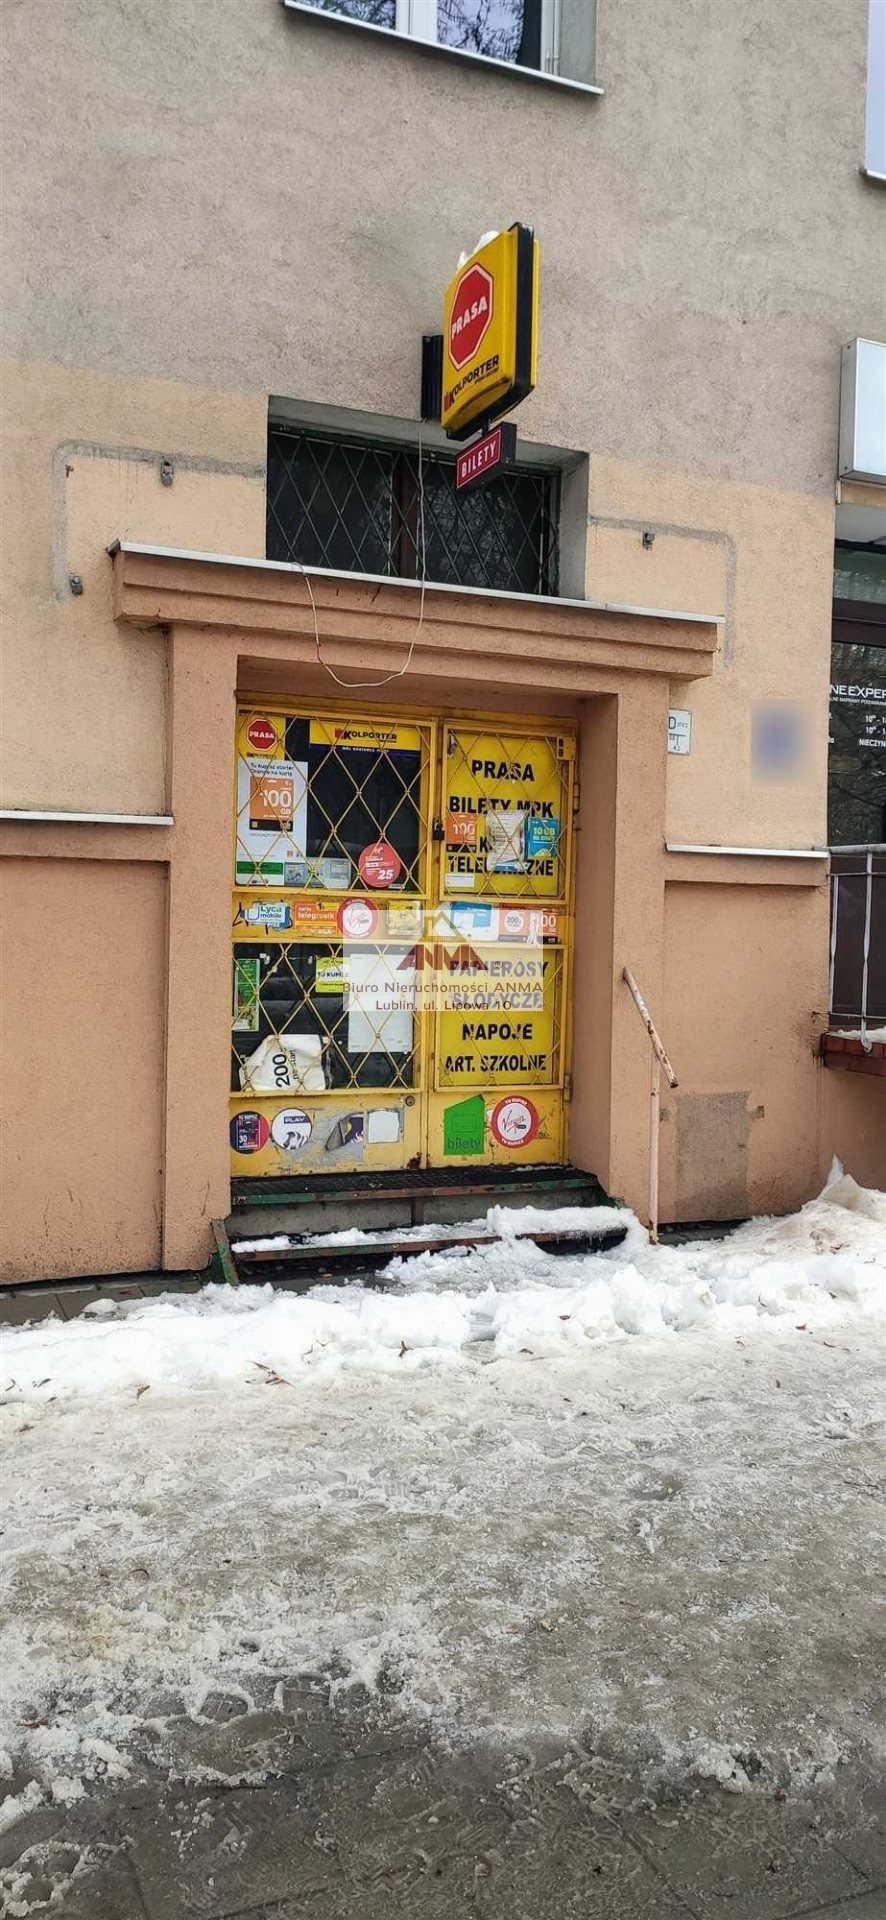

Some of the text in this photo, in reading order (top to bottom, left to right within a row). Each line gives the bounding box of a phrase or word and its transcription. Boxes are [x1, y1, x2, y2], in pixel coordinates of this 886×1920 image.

[451, 295, 488, 341] PRASA
[448, 354, 499, 407] KOLPORTER
[461, 440, 496, 478] BILETY
[249, 730, 275, 740] PRASA
[344, 729, 397, 741] KOLPORTER
[471, 759, 535, 782] PRASA
[259, 789, 292, 807] 100
[449, 796, 554, 818] BILETY MPK
[452, 822, 475, 836] 100
[533, 827, 543, 836] 10
[377, 869, 394, 880] 25
[448, 856, 553, 876] TELEZNE
[260, 905, 283, 915] Lyca
[450, 960, 549, 978] PAPIEROSY
[452, 992, 543, 1009] SŁODYCZE
[462, 1023, 533, 1041] NAPOJE
[272, 1053, 291, 1088] 200
[445, 1055, 547, 1073] ART. SZKOLNE
[501, 1109, 527, 1134] Virgin
[238, 1134, 248, 1143] 30
[447, 1137, 481, 1151] bilety
